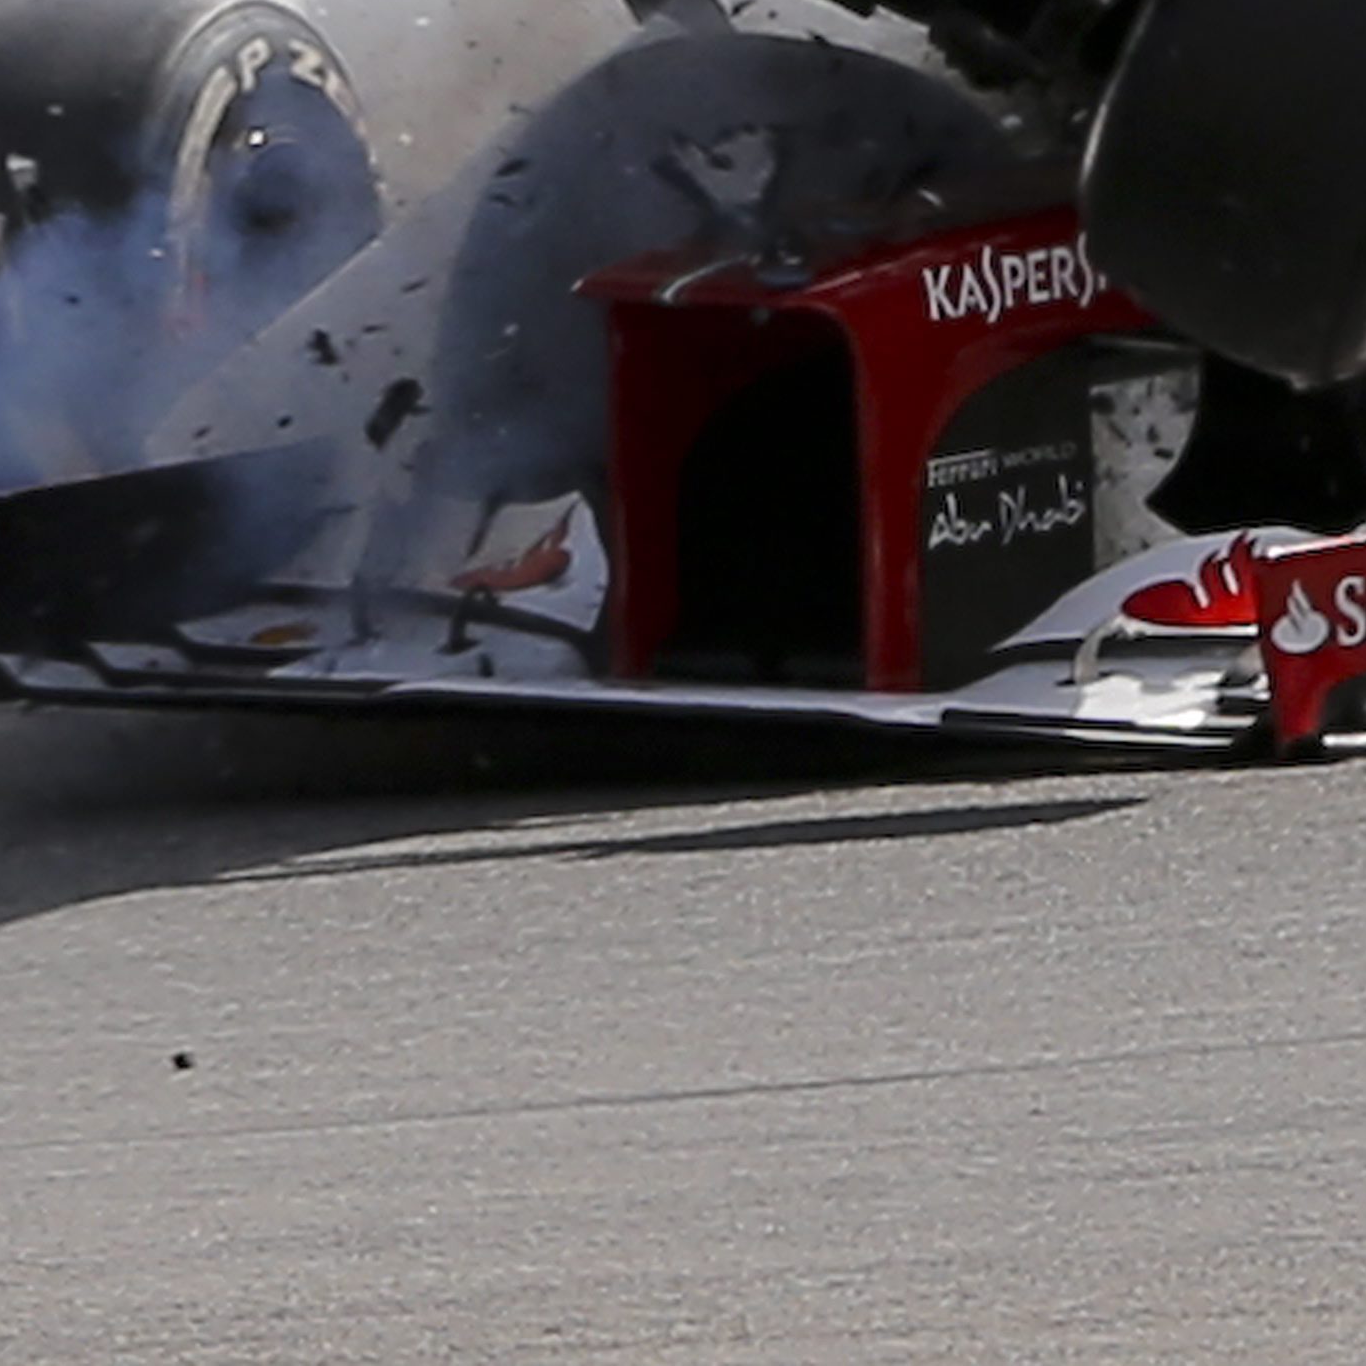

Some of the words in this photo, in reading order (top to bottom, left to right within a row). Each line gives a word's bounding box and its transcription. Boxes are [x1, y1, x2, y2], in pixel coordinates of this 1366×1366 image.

[922, 231, 1108, 325] KASPERS
[928, 491, 993, 550] Abu
[997, 472, 1086, 546] Dhabi
